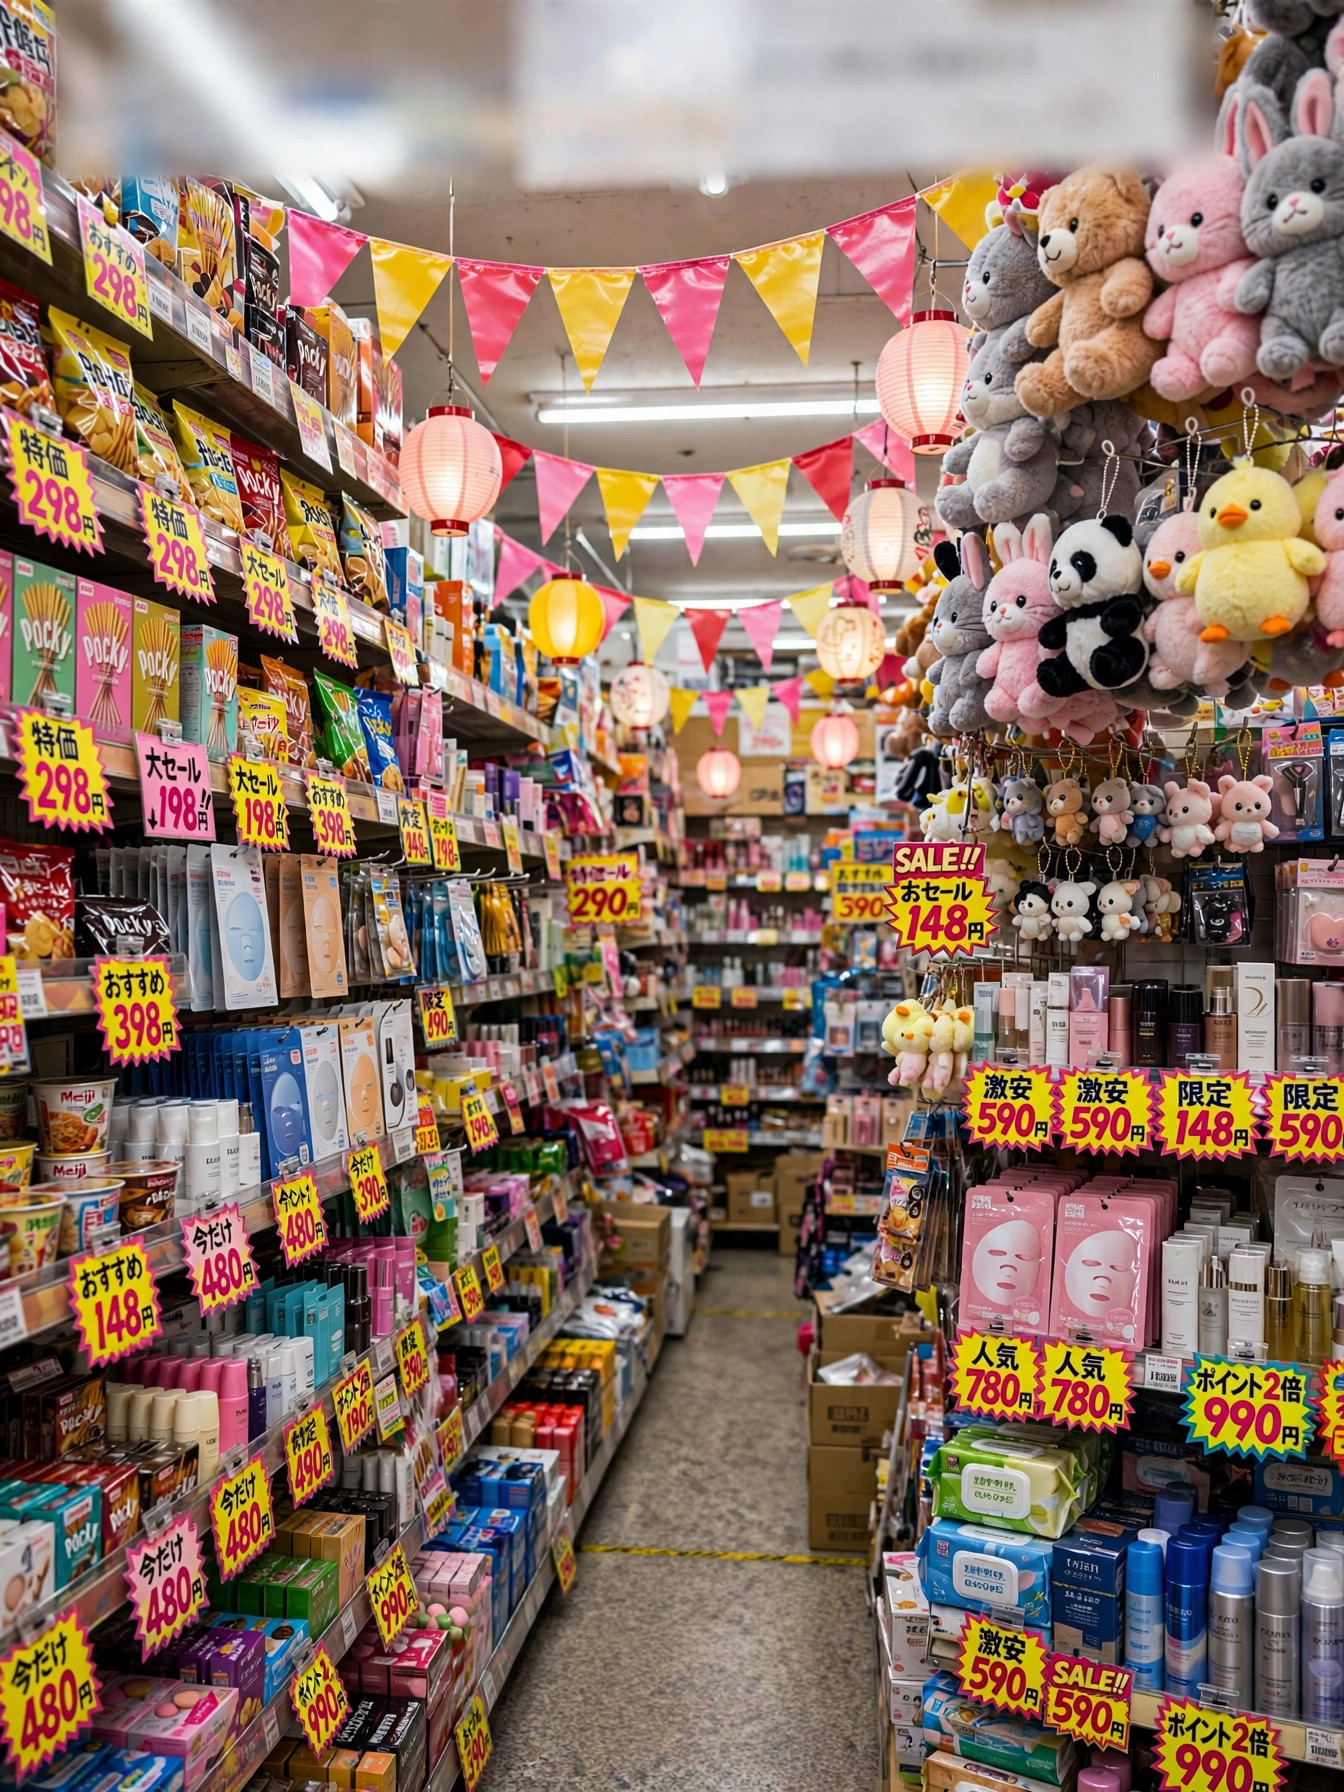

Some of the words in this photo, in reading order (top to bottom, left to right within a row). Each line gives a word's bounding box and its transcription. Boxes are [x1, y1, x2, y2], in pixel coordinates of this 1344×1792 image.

[88, 221, 138, 275] おすすめ
[93, 253, 149, 325] 298円
[19, 429, 69, 481] 特価
[24, 469, 95, 540] 298円
[151, 497, 189, 541] 特価
[156, 533, 210, 591] 298円
[247, 551, 286, 589] 大セール
[252, 581, 294, 631] 298円
[31, 720, 79, 762] 特価
[145, 747, 202, 784] 大セール
[235, 765, 278, 795] 大セール
[35, 761, 105, 815] 298円
[310, 781, 345, 809] おすすめ
[318, 808, 352, 848] 398円
[895, 846, 981, 873] SALE!!
[572, 887, 639, 917] 290円
[900, 880, 973, 903] おセール
[906, 904, 985, 942] 148円
[104, 968, 165, 999] おすすめ
[113, 1001, 174, 1050] 398円
[984, 1074, 1033, 1101] 激安
[1077, 1077, 1129, 1105] 激安
[1178, 1080, 1232, 1108] 限定
[1283, 1083, 1339, 1112] 限定
[977, 1102, 1049, 1137] 590円
[1069, 1106, 1145, 1142] 590円
[1176, 1110, 1249, 1147] 148円
[358, 1174, 387, 1212] 390円
[192, 1217, 232, 1255] 今だけ
[286, 1208, 324, 1252] 480円
[79, 1253, 143, 1299] おすすめ
[202, 1247, 254, 1301] 480円
[95, 1288, 155, 1350] 148円
[971, 1341, 1019, 1371] 人気
[1055, 1351, 1106, 1381] 人気
[966, 1368, 1033, 1410] 780円
[1051, 1378, 1124, 1422] 780円
[1196, 1366, 1303, 1404] ポイント2倍
[1203, 1396, 1300, 1447] 990円
[295, 1440, 332, 1493] 490円
[220, 1471, 256, 1518] 今だけ
[226, 1502, 271, 1560] 480円
[139, 1533, 183, 1585] 今だけ
[146, 1566, 203, 1637] 480円
[11, 1632, 68, 1695] 今だけ
[978, 1627, 1026, 1664] 激安
[969, 1655, 1039, 1707] 590円
[1052, 1660, 1130, 1695] SALE!!
[21, 1668, 94, 1752] 480円
[1052, 1688, 1125, 1741] 590円
[1167, 1712, 1270, 1758] ポイント2倍
